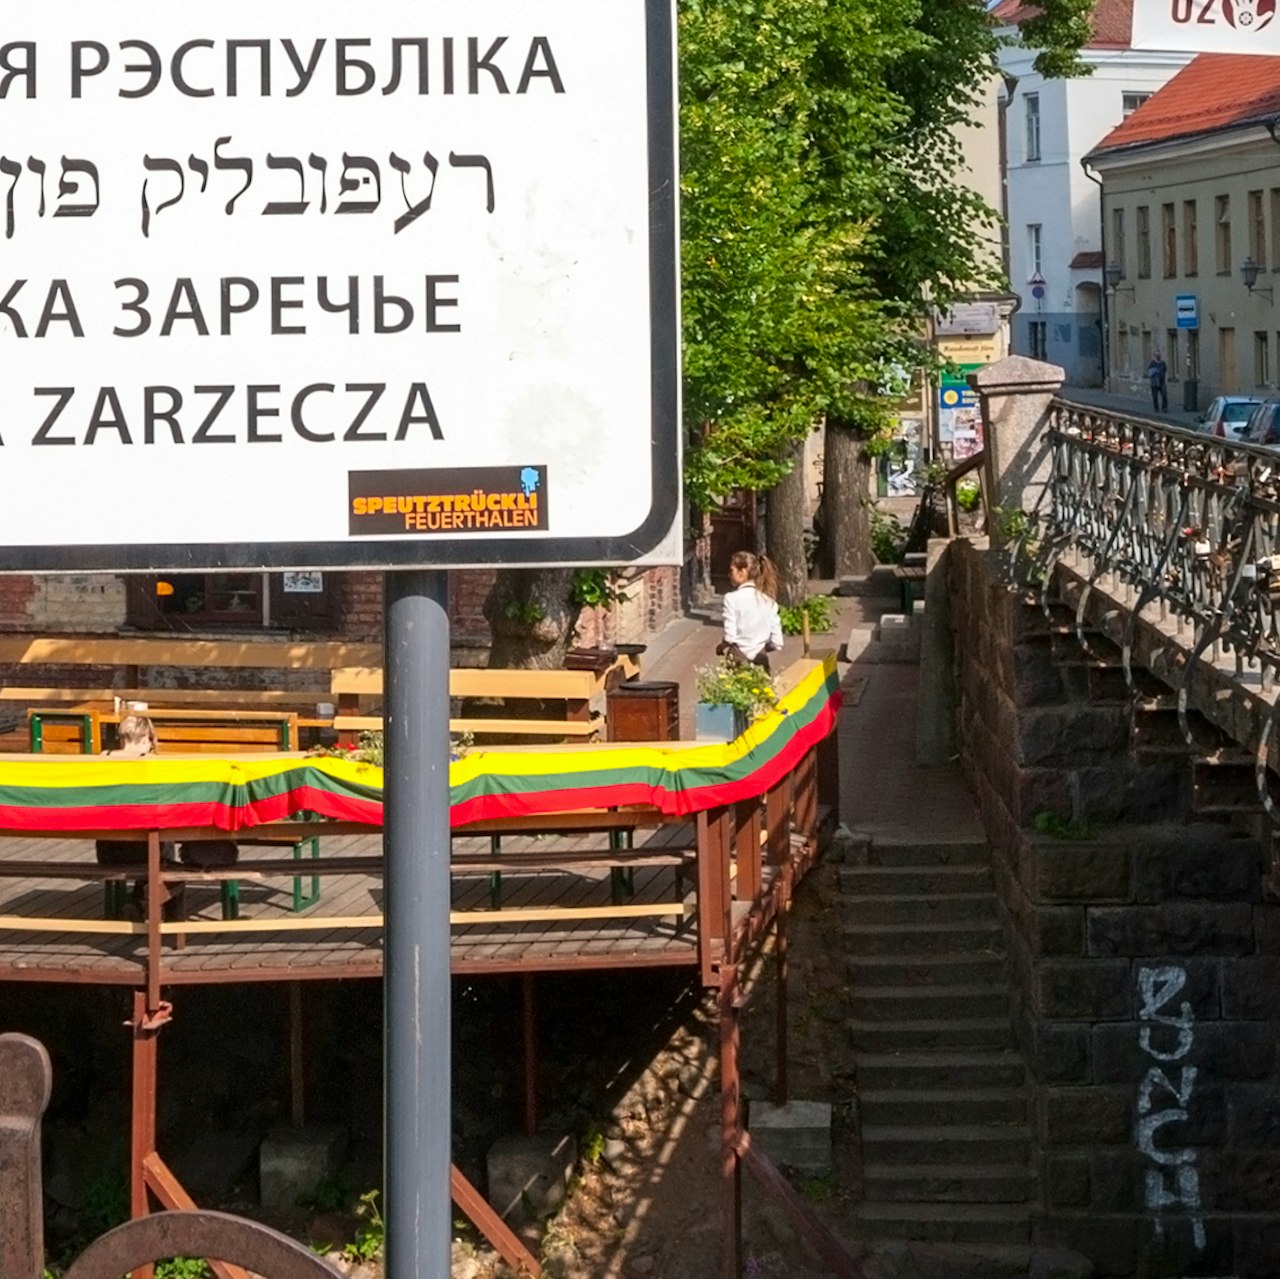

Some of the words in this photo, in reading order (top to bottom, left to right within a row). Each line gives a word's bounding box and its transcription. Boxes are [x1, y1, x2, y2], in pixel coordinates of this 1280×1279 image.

[72, 37, 565, 98] РЭСПУБЛІКА
[0, 156, 99, 239] פון
[113, 275, 460, 337] ЗАРЕЧЬЕ
[32, 383, 444, 445] ZARZECZA
[353, 489, 537, 514] SPEUTZTRÜCKLI
[405, 510, 538, 529] FEUERTHALEN
